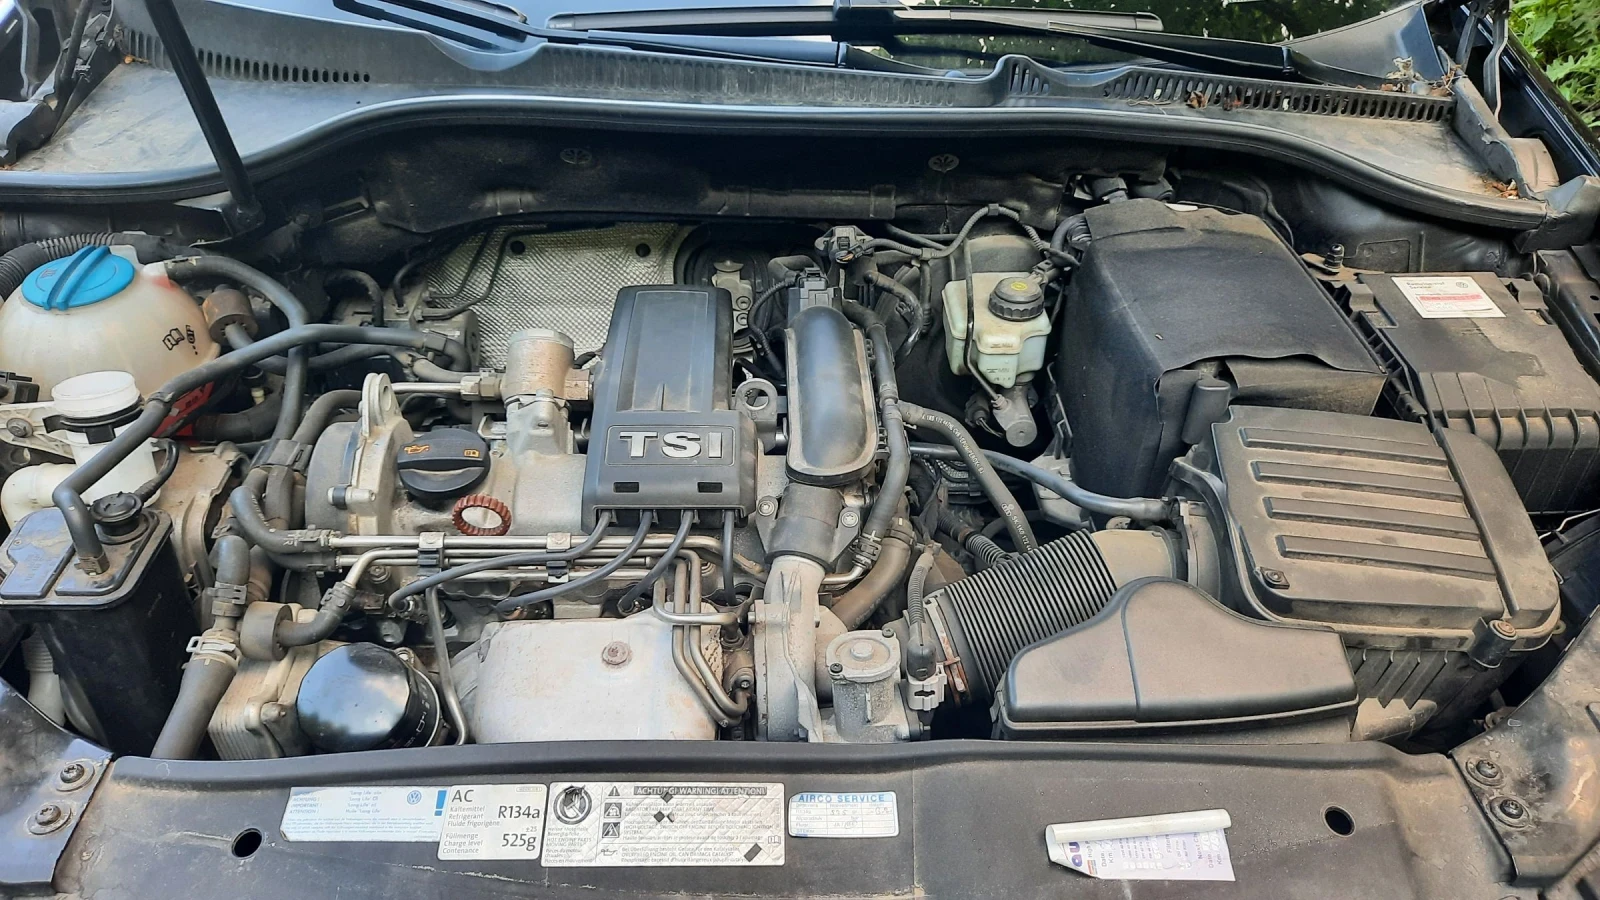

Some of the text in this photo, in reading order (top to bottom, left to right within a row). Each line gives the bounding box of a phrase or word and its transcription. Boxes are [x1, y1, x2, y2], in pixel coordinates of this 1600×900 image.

[619, 431, 722, 458] TSI
[451, 789, 474, 802] AC
[680, 787, 719, 795] WARNING!
[798, 794, 884, 802] AIRCO SERVICE
[448, 813, 484, 821] Refrigerant
[498, 805, 541, 819] R134a
[444, 840, 466, 848] Charge
[501, 833, 537, 851] 525g
